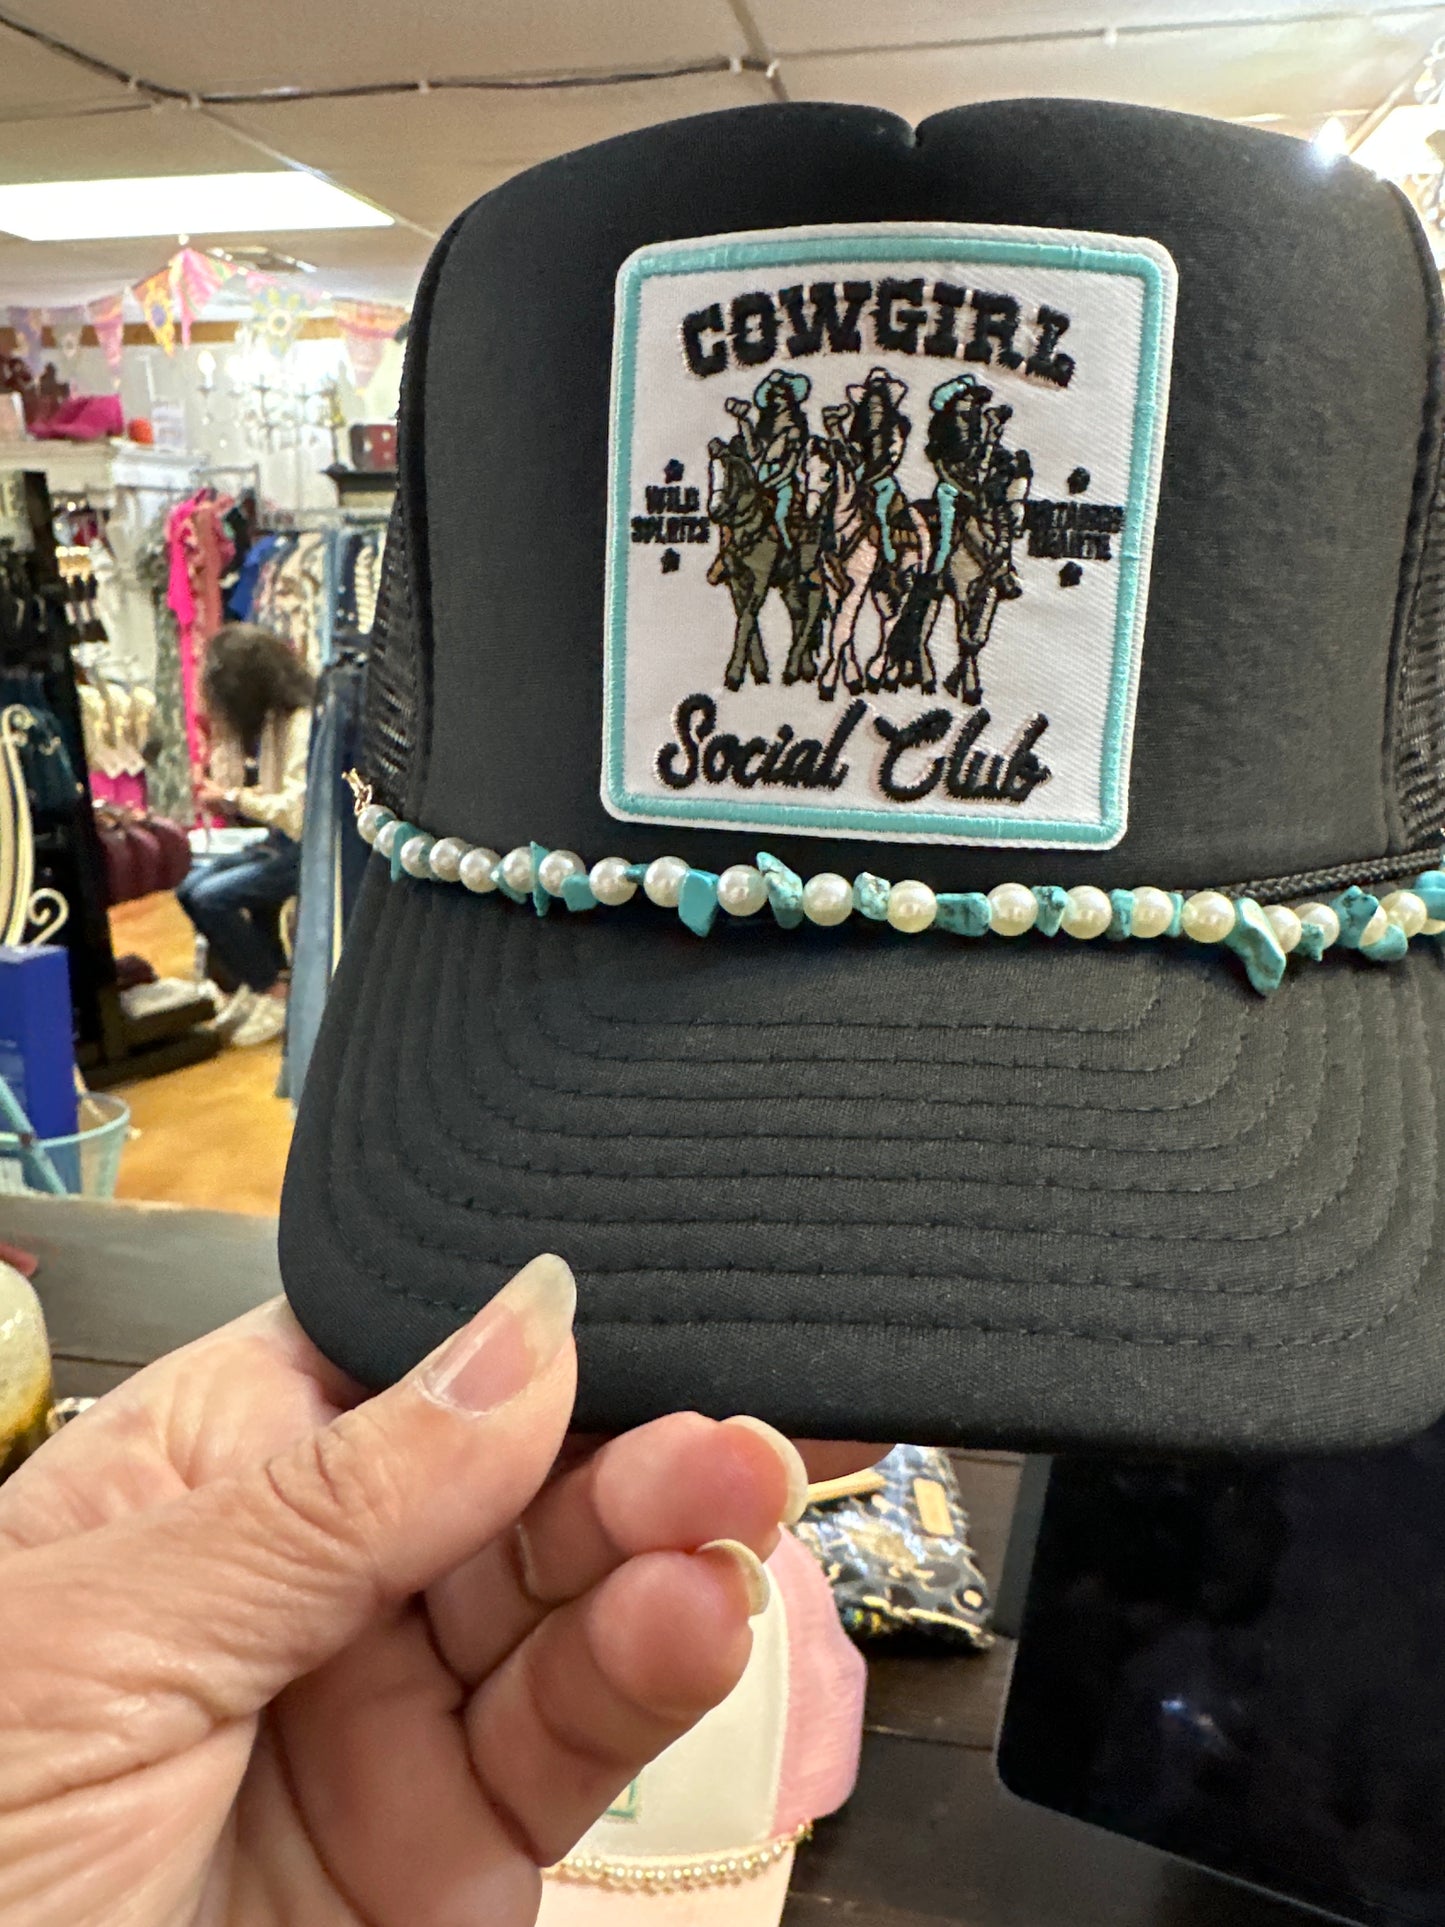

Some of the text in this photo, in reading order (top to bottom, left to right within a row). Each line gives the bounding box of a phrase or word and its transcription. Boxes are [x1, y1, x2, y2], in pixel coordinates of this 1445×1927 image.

[682, 278, 1076, 388] COWGIRL
[656, 693, 1051, 803] Social Club
